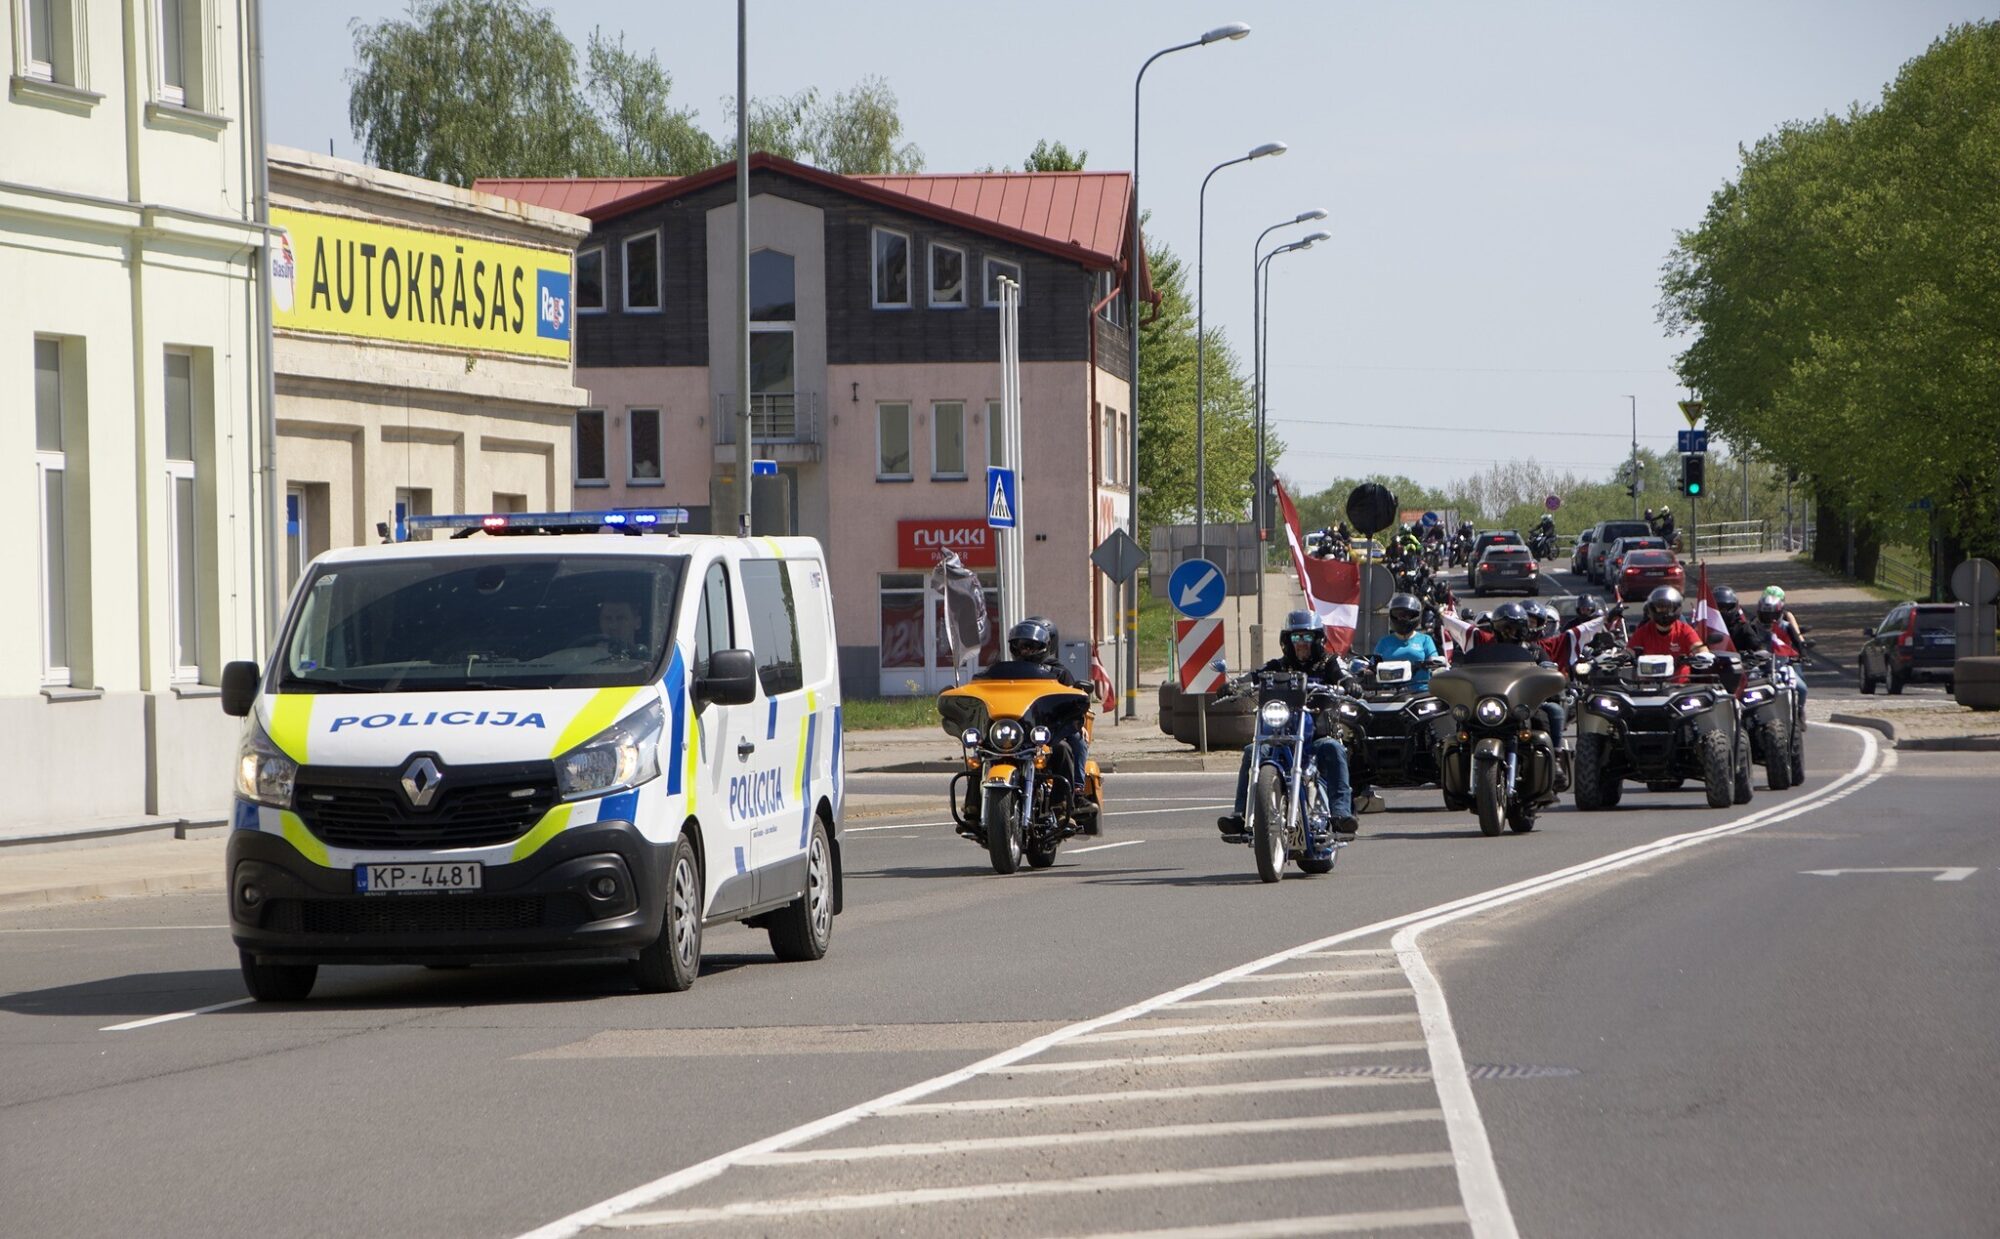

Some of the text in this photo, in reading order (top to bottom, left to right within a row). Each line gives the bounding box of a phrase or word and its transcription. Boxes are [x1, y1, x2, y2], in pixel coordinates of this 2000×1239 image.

[310, 236, 524, 334] AUTOKRĀSAS
[329, 711, 546, 733] POLICIJA
[729, 766, 785, 821] POLICIJA
[372, 865, 476, 888] KP-4481
